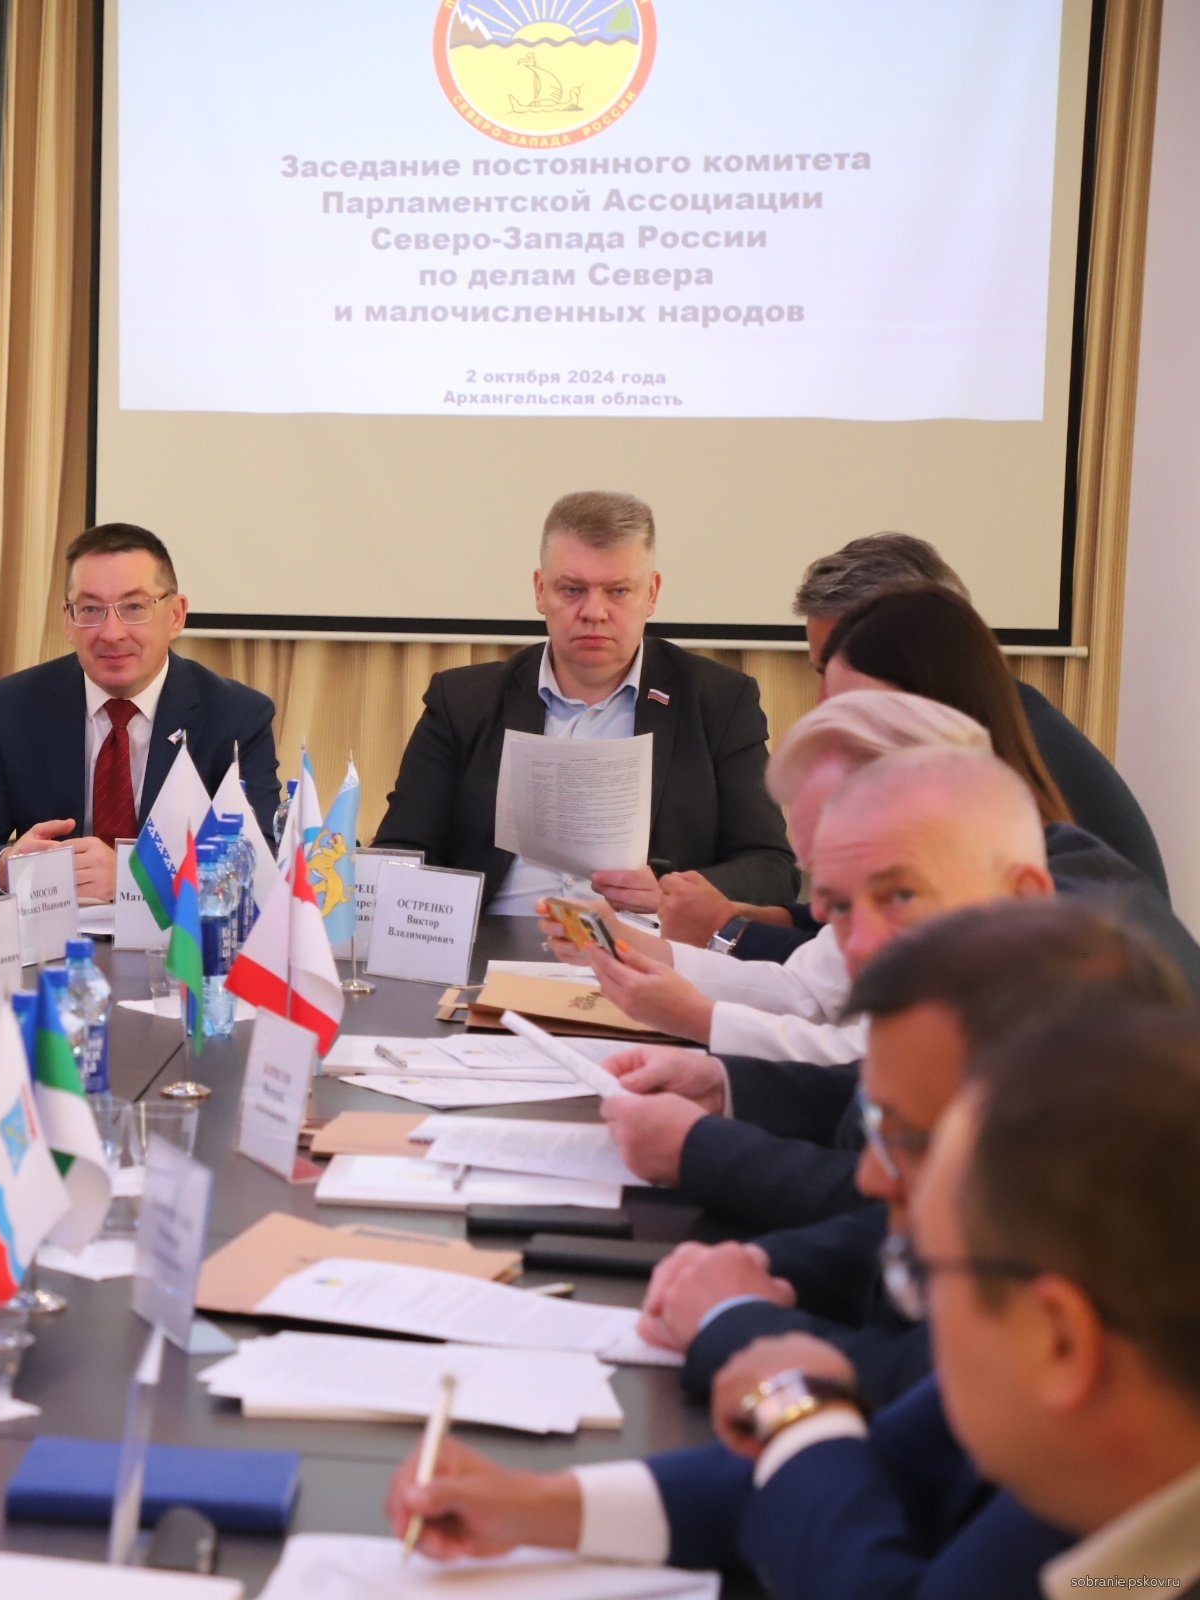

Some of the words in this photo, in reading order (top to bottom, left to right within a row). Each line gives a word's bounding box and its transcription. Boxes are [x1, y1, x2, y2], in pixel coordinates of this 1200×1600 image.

[453, 95, 571, 148] СЕВЕРО-ЗАПАДА
[582, 91, 637, 137] РОССИИ
[280, 154, 461, 181] Заседание
[472, 155, 691, 177] постоянного
[703, 151, 872, 173] комитета
[321, 188, 591, 220] Парламентской
[602, 188, 823, 214] Ассоциации
[371, 226, 625, 256] Северо-Запада
[637, 225, 767, 249] России
[418, 268, 458, 286] по
[467, 268, 576, 290] делам
[587, 262, 714, 292] Севера
[333, 304, 353, 322] и
[364, 304, 646, 323] малочисленных
[657, 303, 806, 328] народов
[465, 369, 477, 383] 2
[482, 369, 561, 387] октября
[567, 370, 616, 384] 2024
[621, 372, 667, 386] года
[443, 390, 596, 407] Архангельская
[601, 391, 684, 406] область
[397, 898, 454, 915] ОСТРЕНКО
[406, 914, 440, 930] Виктор
[387, 926, 455, 945] Владимирович
